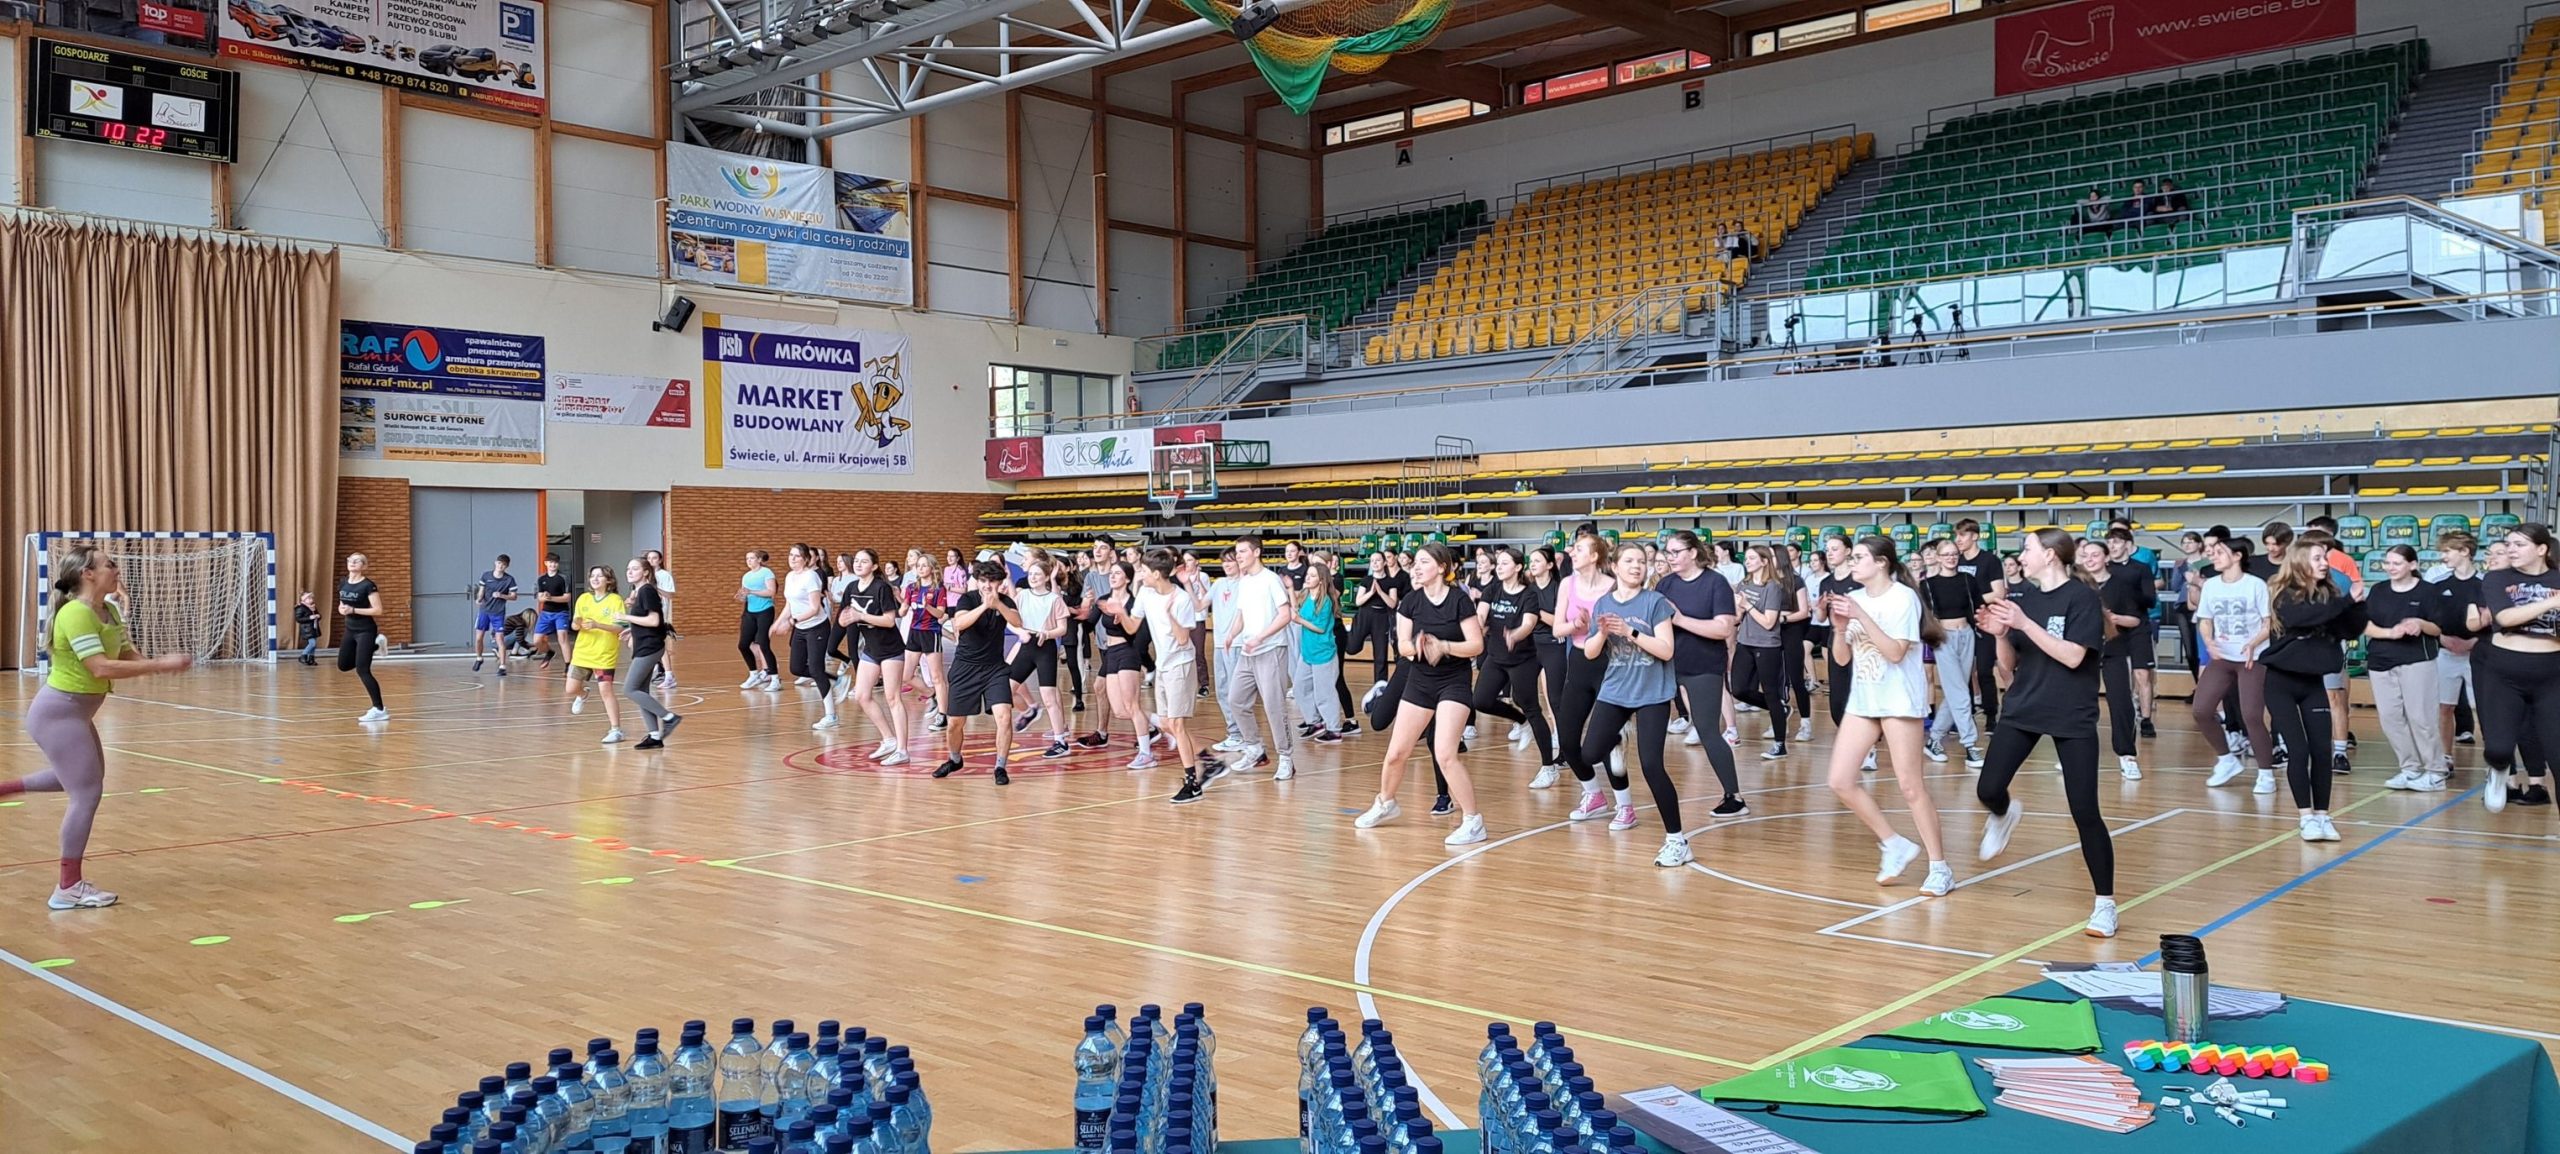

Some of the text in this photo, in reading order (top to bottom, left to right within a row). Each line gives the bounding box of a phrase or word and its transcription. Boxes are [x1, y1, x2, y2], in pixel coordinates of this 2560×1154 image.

[143, 4, 167, 20] top
[314, 6, 370, 22] PRZYCZEPY
[330, 0, 370, 14] KAMPER
[388, 3, 466, 26] POMOC DROGOWA
[388, 12, 456, 32] PRZEWÓZ OSÓB
[388, 21, 458, 40] AUTO DO ŚLUBU
[503, 12, 520, 36] P
[54, 46, 110, 64] GOSPODARZE
[252, 50, 298, 65] Sikorskiego
[180, 67, 208, 80] GOŚCIE
[361, 70, 449, 94] +48 729 874 520
[1686, 90, 1700, 110] B
[71, 120, 88, 128] FAUL
[103, 123, 166, 146] 10 22
[1398, 149, 1411, 166] A
[680, 193, 712, 208] PARK
[713, 198, 762, 216] WODNY
[764, 207, 777, 218] W
[676, 212, 906, 256] Centrum rozrywki dla całej rodziny!
[341, 332, 401, 355] RAF
[465, 336, 522, 349] spawalnictwo
[718, 334, 743, 359] psb
[445, 354, 486, 366] armatura
[468, 346, 520, 358] pneumatyka
[774, 340, 855, 366] MRÓWKA
[372, 362, 400, 374] Górski
[486, 368, 537, 378] skrawaniem
[341, 376, 432, 391] www.raf-mix.pl
[737, 383, 844, 412] MARKET
[384, 412, 485, 424] SUROWCE WTÓRNE
[733, 414, 844, 434] BUDOWLANY
[384, 432, 414, 444] SKUP
[415, 432, 479, 448] SUROWCÓW
[730, 446, 908, 468] Świecie, ul. Armii Krajowej 5B
[1063, 437, 1101, 468] eko
[2350, 528, 2365, 536] VIP
[2398, 528, 2412, 536] VIP
[729, 1124, 760, 1137] SELENKA
